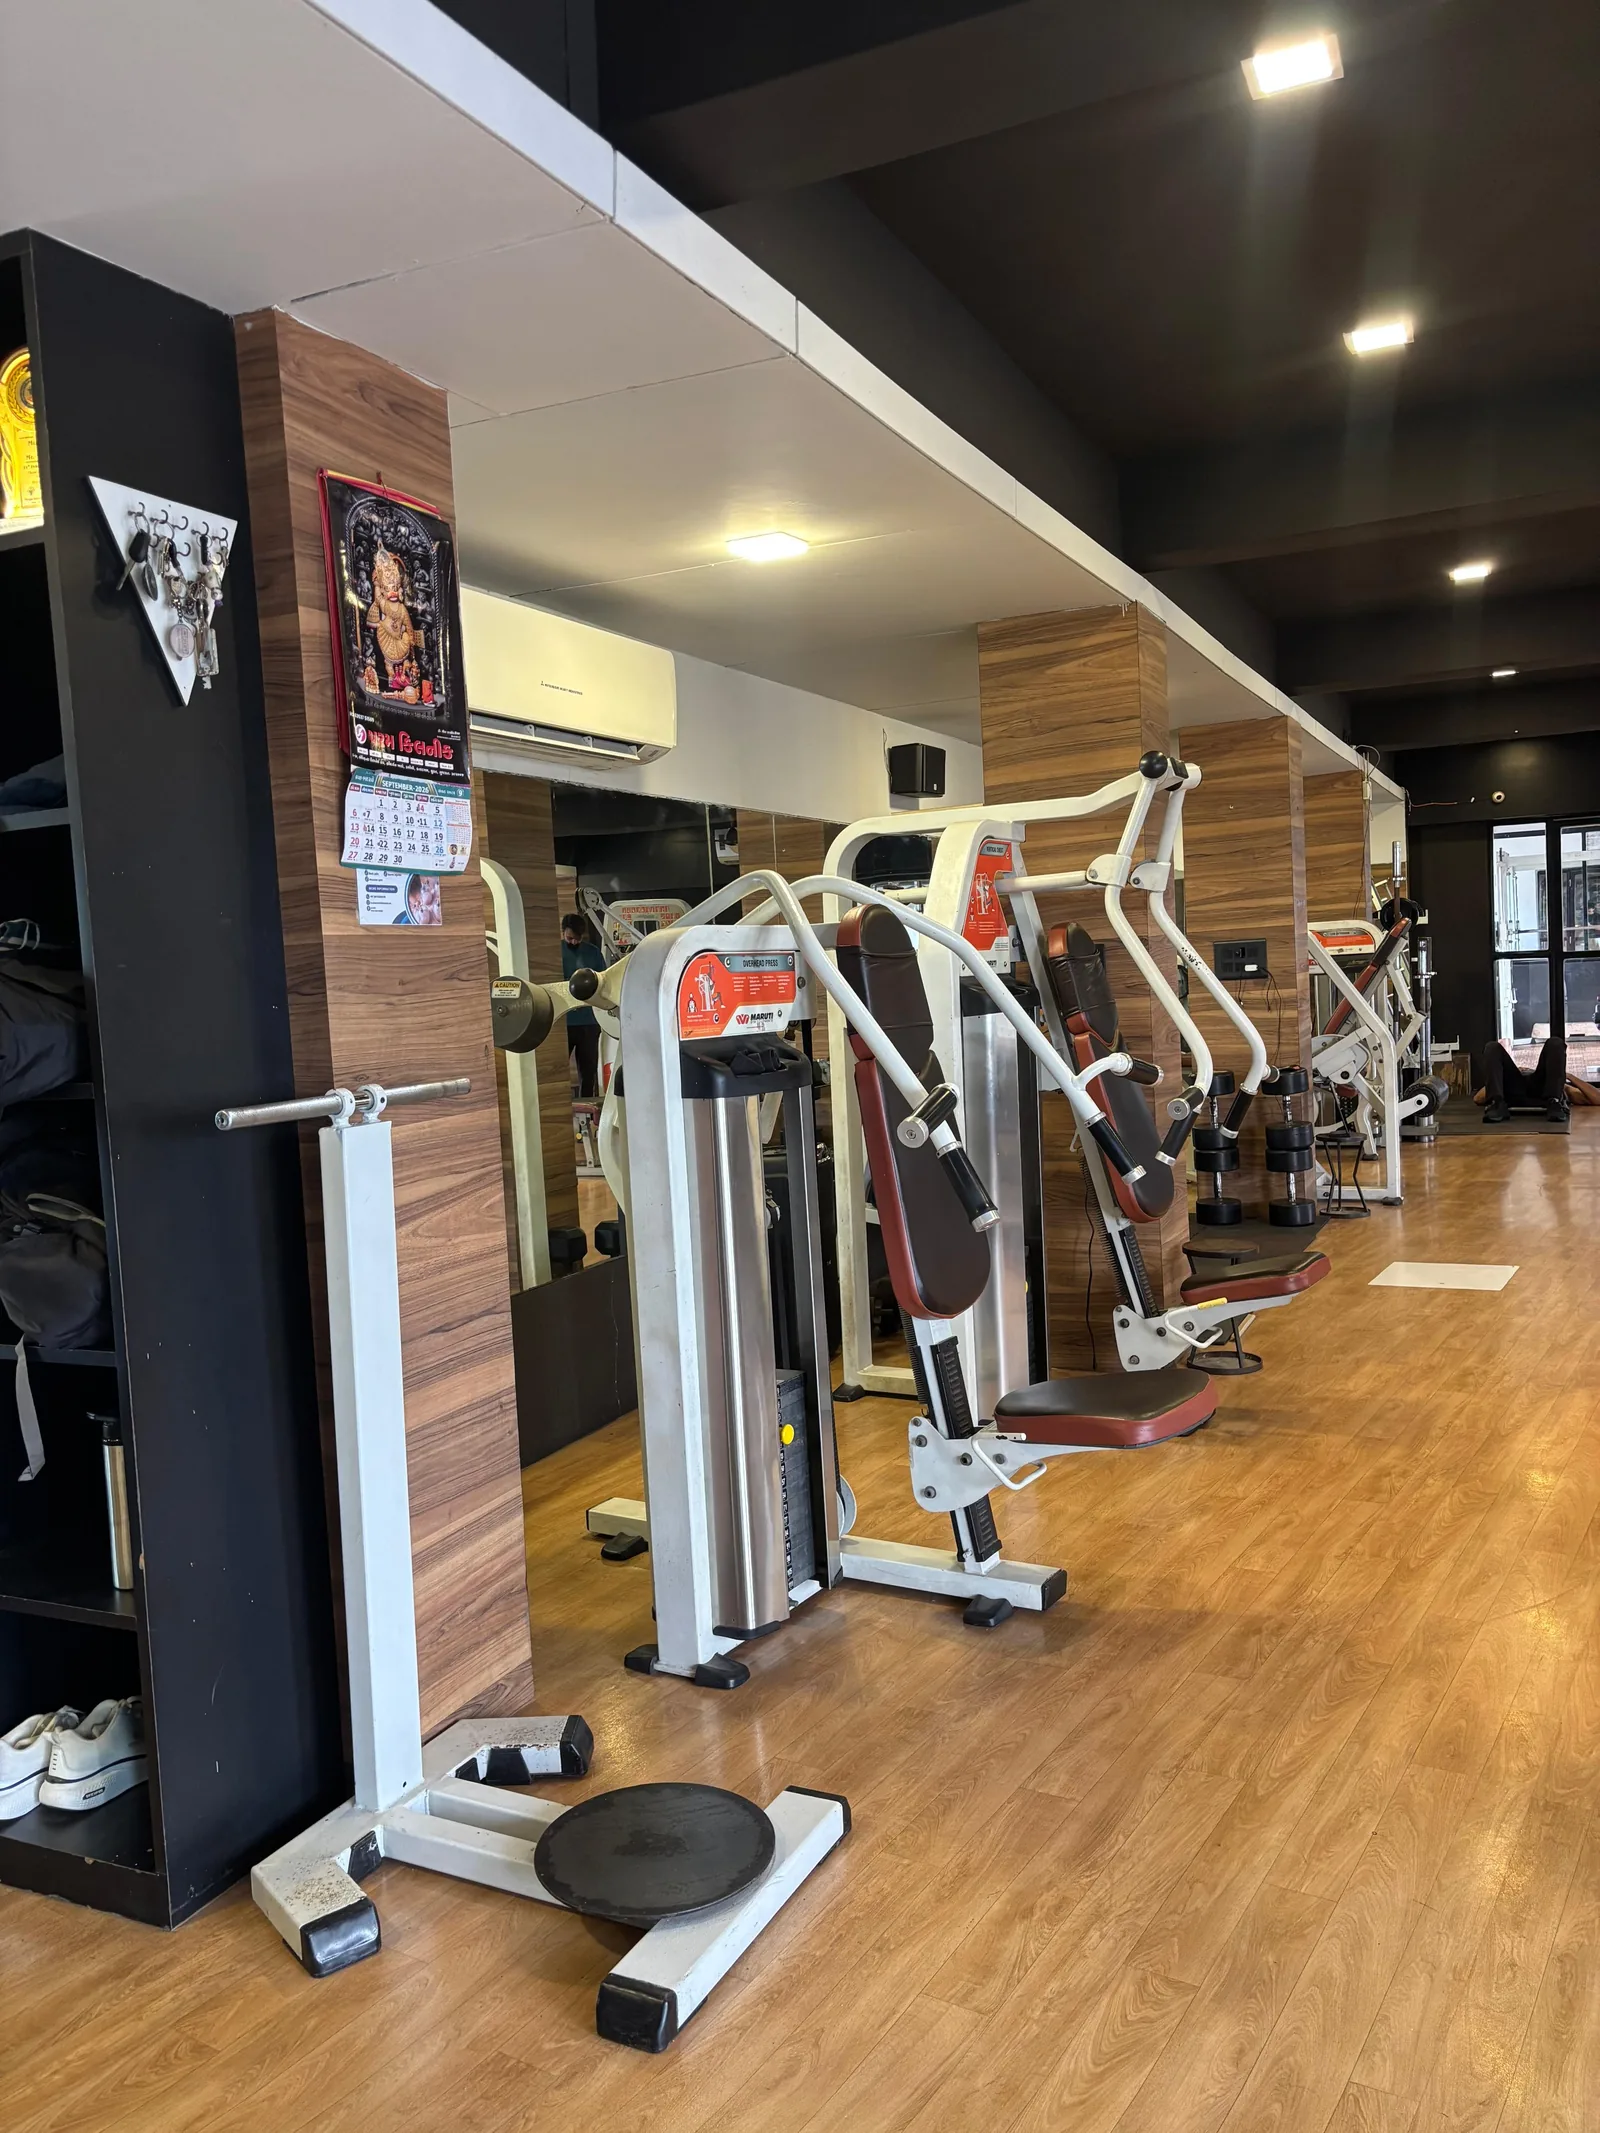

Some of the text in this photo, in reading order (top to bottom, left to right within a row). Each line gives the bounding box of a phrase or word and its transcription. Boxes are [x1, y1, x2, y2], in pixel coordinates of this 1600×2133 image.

[382, 780, 429, 794] SEPTEMBER-2026
[367, 825, 375, 833] 14
[743, 960, 765, 968] OVERHEAD
